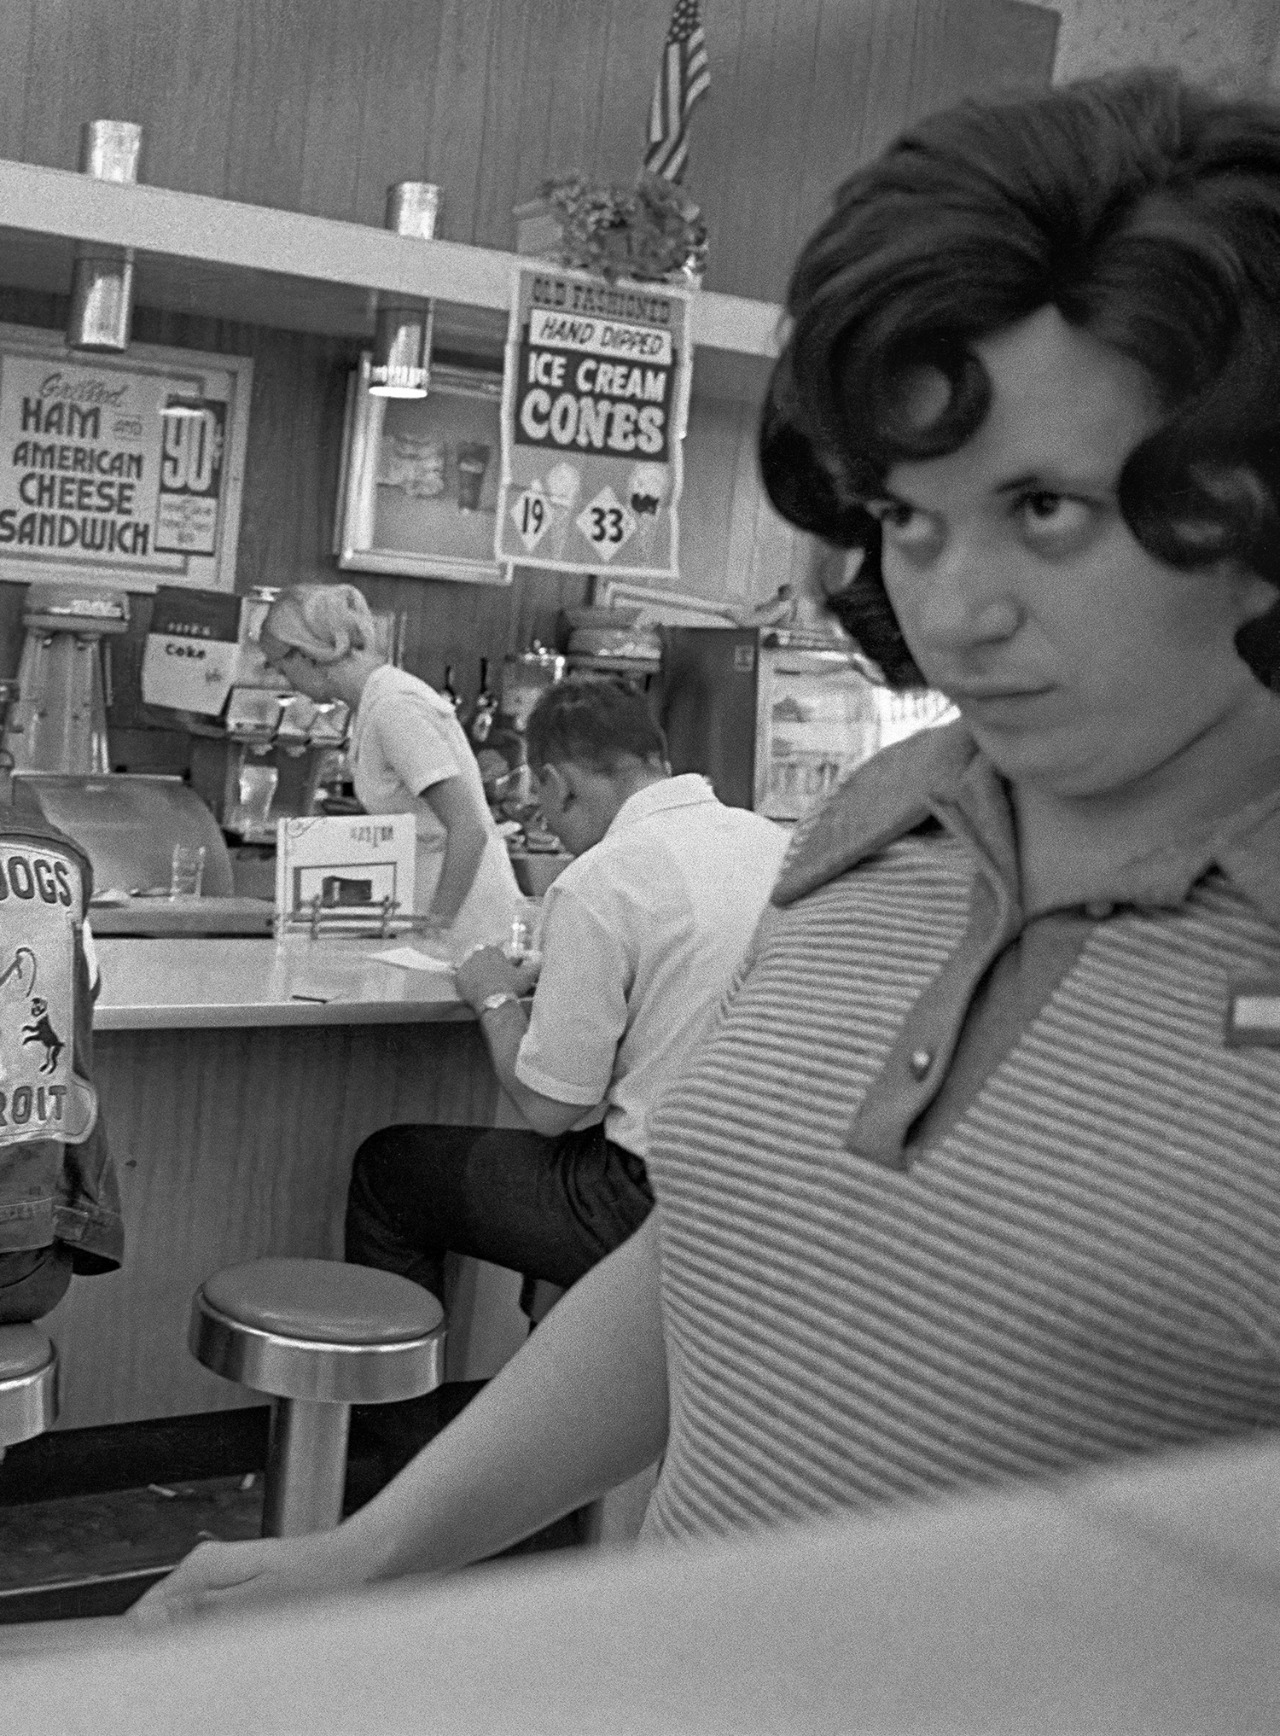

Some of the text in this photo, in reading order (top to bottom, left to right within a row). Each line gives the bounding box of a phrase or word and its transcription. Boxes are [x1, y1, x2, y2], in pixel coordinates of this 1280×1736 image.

[533, 277, 566, 306] OLD
[540, 316, 665, 356] HAND DIPPED
[528, 351, 667, 403] ICE CREAM
[22, 397, 101, 440] HAM
[520, 387, 665, 455] CONES
[13, 441, 145, 481] AMERICAN
[20, 471, 136, 516] CHEESE
[522, 497, 544, 535] 19
[591, 506, 624, 543] 33
[165, 643, 206, 660] Coke
